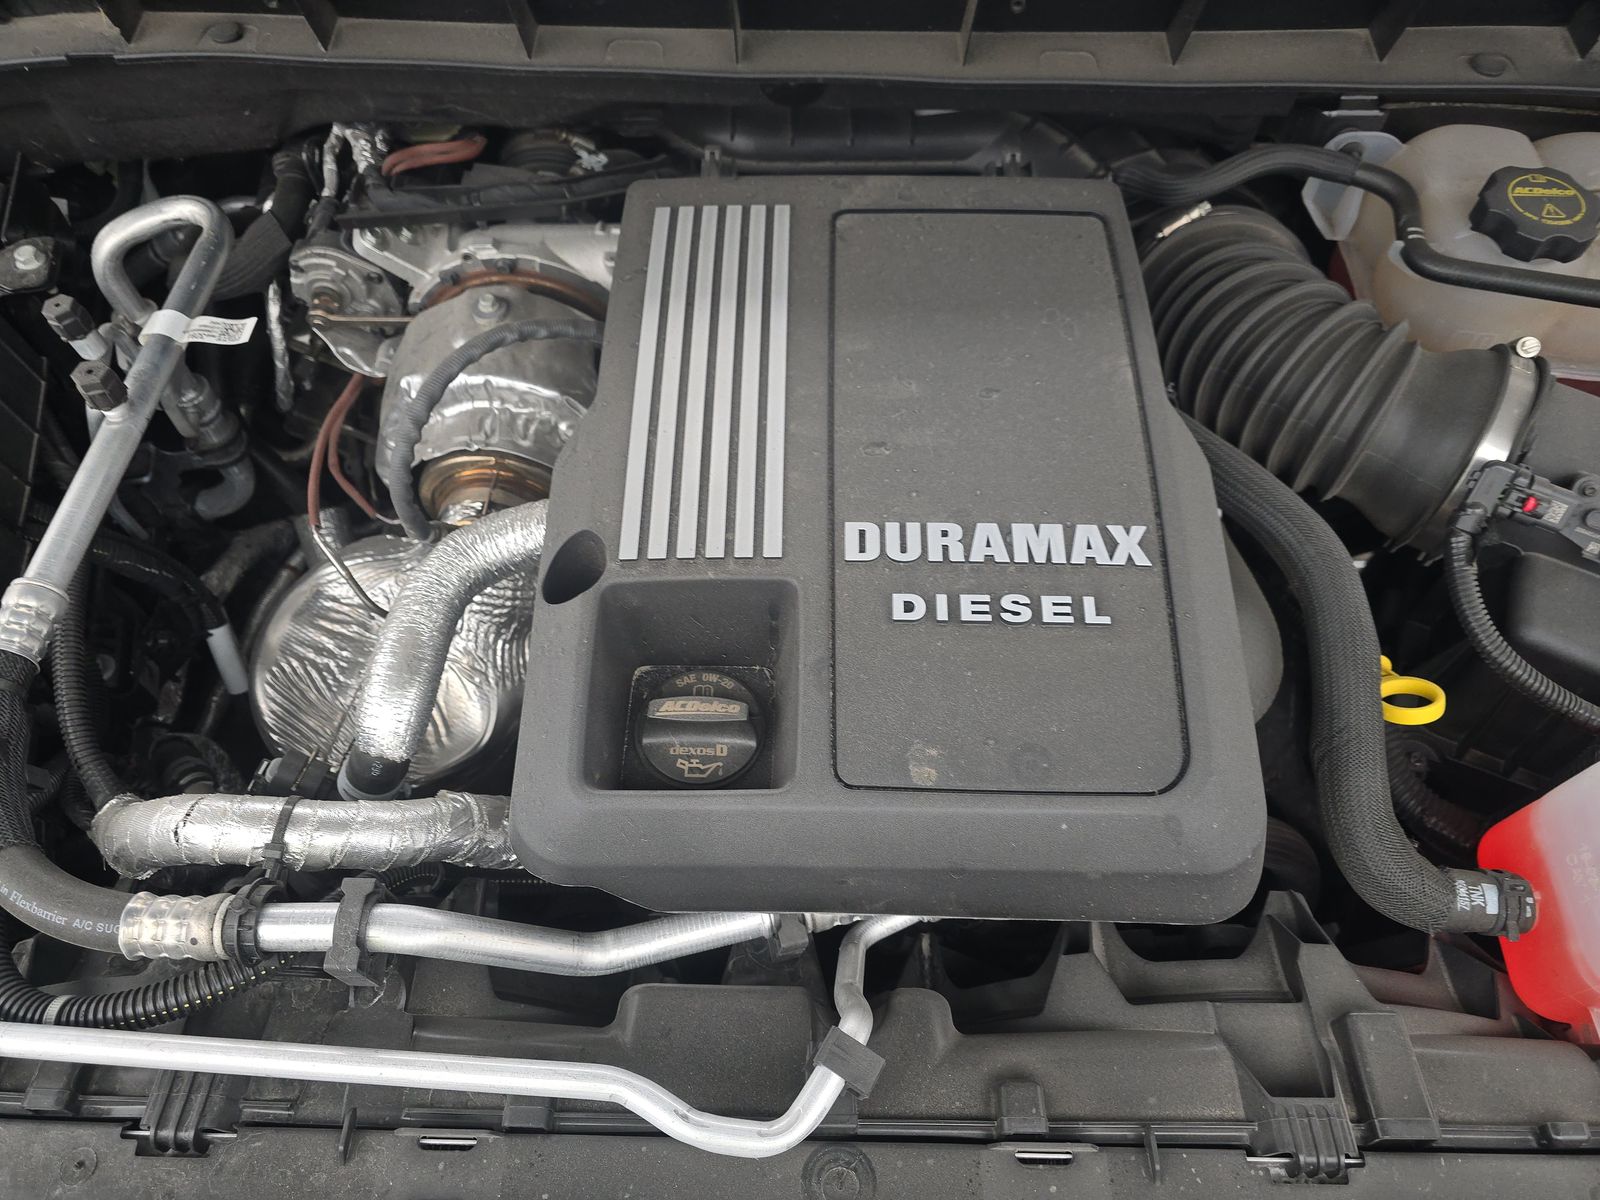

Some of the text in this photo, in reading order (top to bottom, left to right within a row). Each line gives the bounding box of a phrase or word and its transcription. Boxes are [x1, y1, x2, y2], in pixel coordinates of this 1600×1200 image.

[844, 521, 1153, 567] DURAMAX
[891, 593, 1112, 626] DIESEL
[675, 674, 697, 688] SAE
[658, 701, 741, 713] ACDelco
[9, 890, 68, 926] Flexbarrier
[72, 918, 93, 931] A/C
